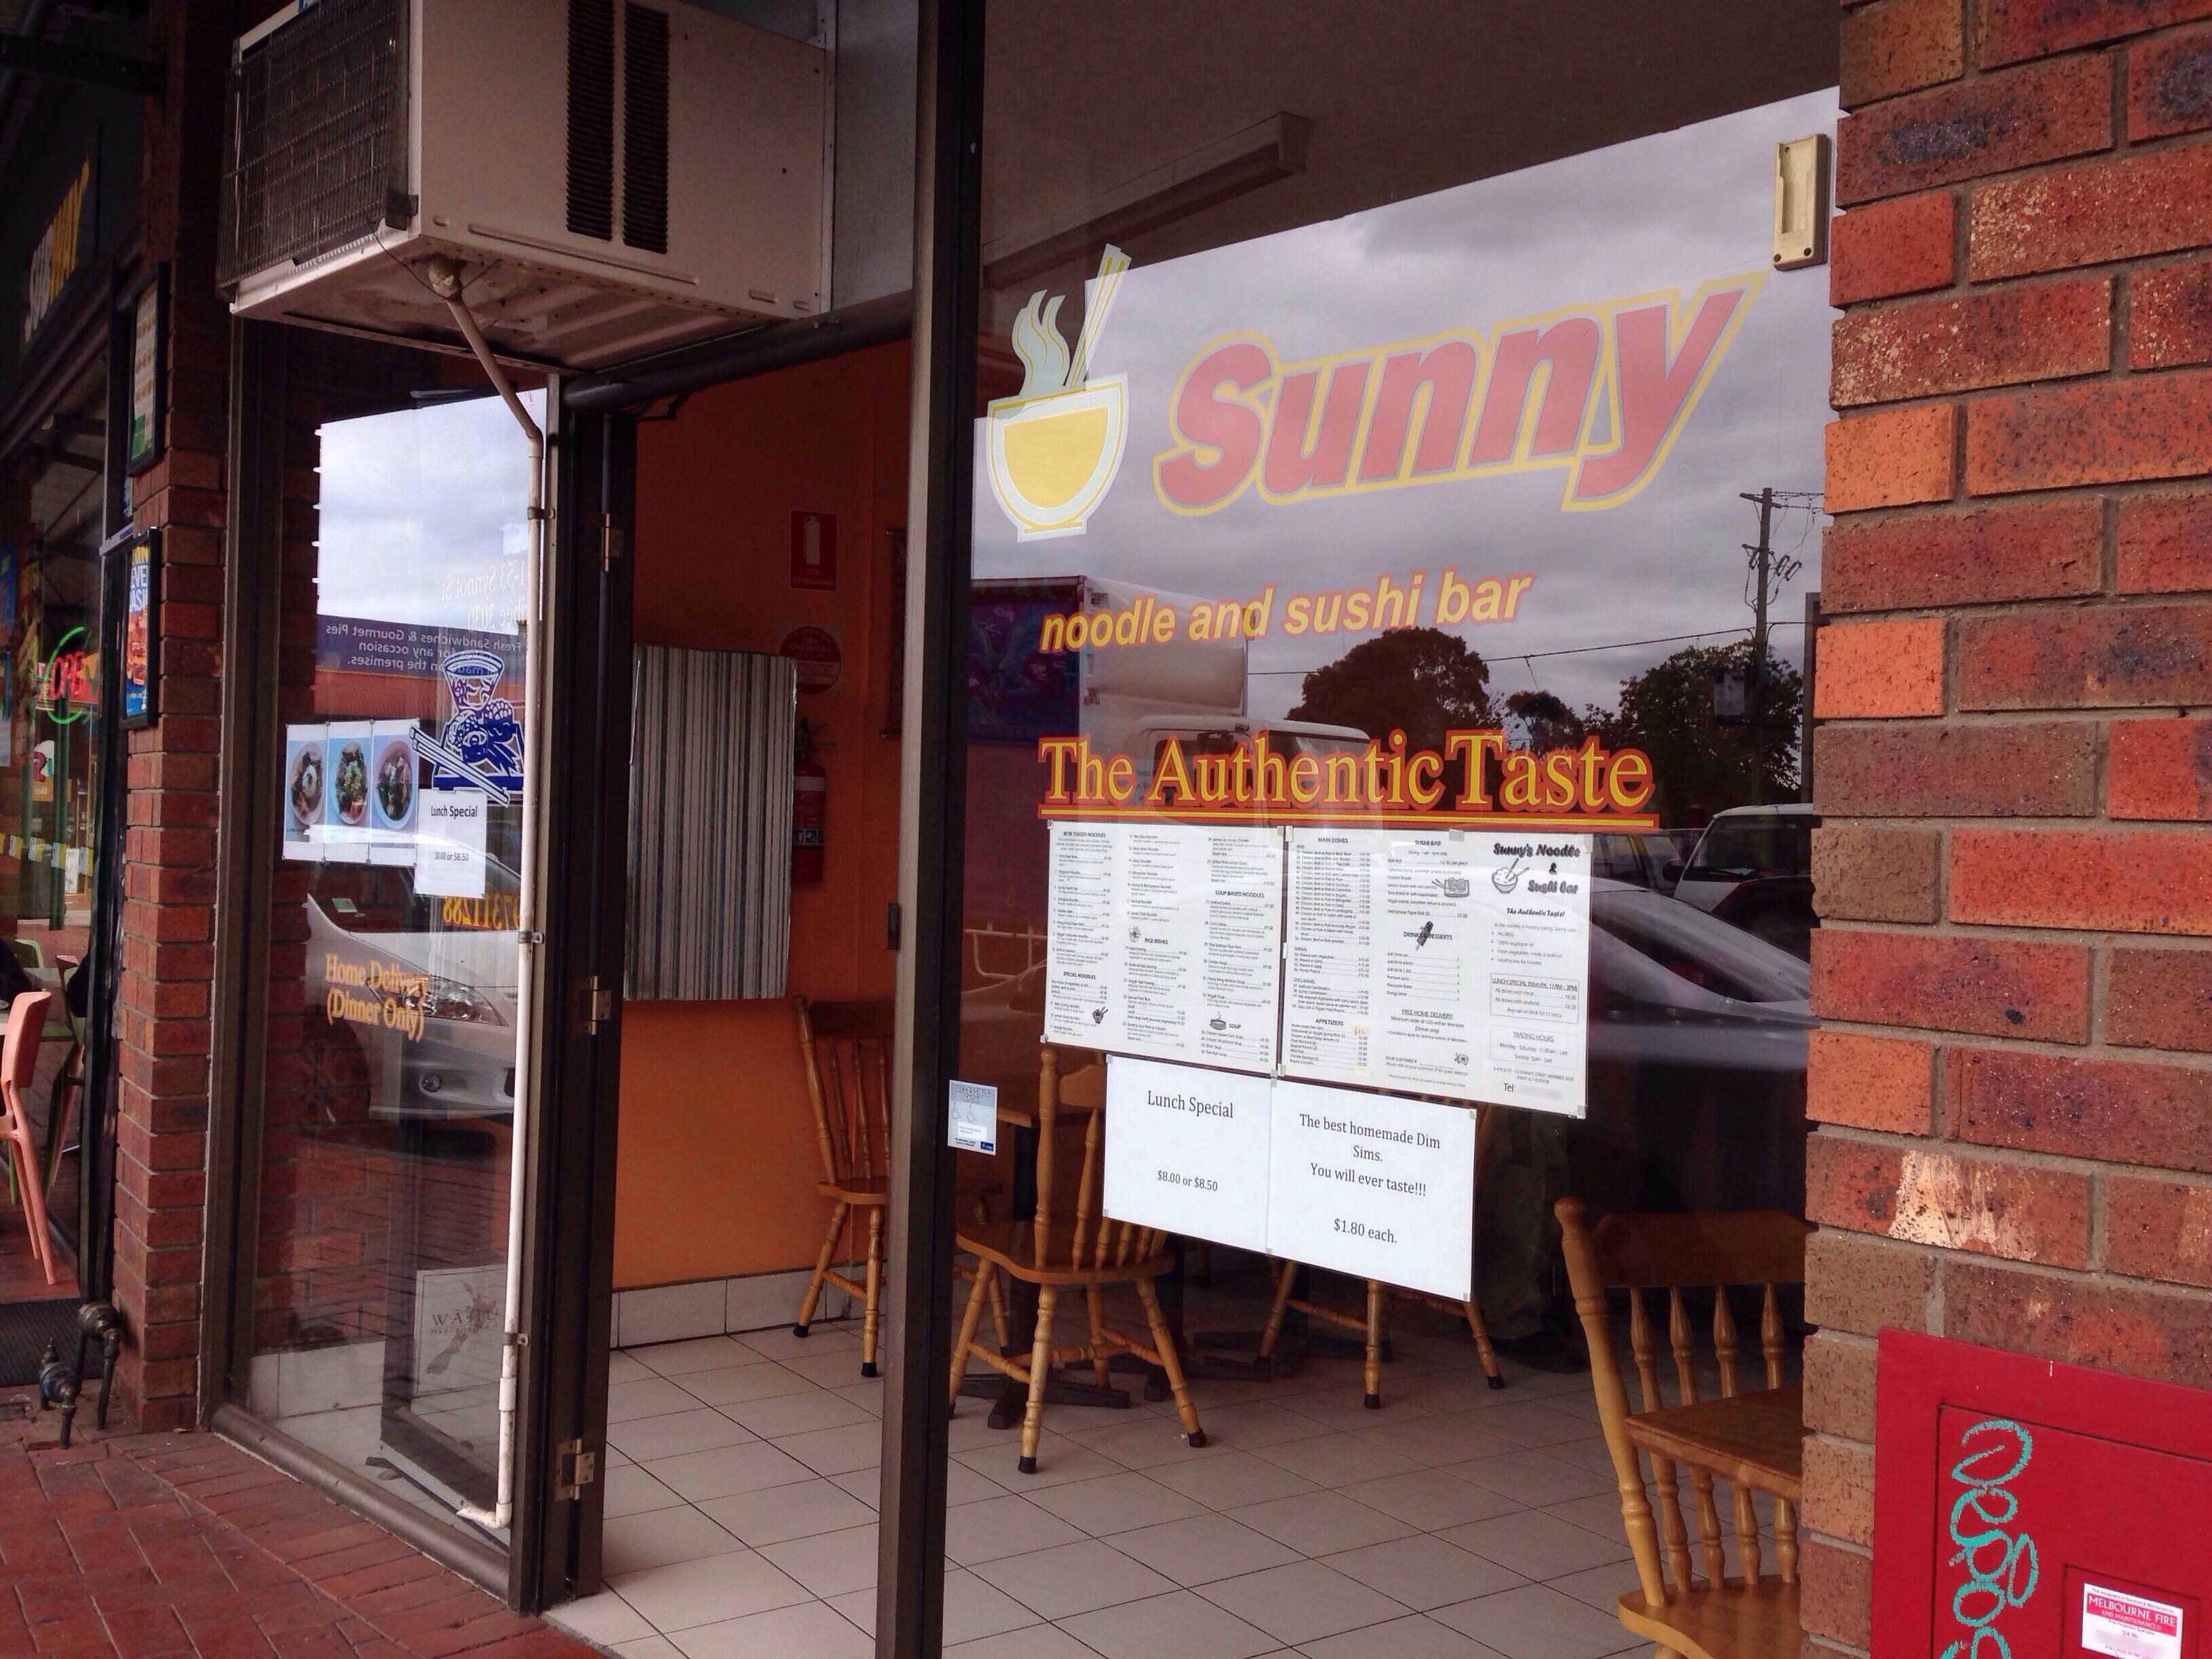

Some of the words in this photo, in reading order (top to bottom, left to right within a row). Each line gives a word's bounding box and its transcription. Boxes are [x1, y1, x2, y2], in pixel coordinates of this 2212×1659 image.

[1152, 271, 1765, 515] Sunny
[1039, 594, 1176, 653] noodle
[1188, 583, 1275, 640] and
[1284, 570, 1424, 636] sushi
[1436, 567, 1534, 626] bar
[1038, 733, 1136, 804] The
[1147, 729, 1446, 810] Authentic
[1446, 727, 1656, 813] Taste
[431, 805, 447, 817] Lunch
[449, 806, 477, 819] Special
[453, 853, 469, 861] $8.50
[1493, 843, 1534, 857] Sunny's
[1536, 844, 1580, 857] Noodle
[1549, 863, 1557, 875] &
[1528, 880, 1557, 894] Sushi
[1518, 908, 1546, 916] Authentic
[325, 952, 366, 987] Home
[369, 959, 429, 1002] Delivery
[327, 987, 381, 1025] (Dinner
[383, 998, 424, 1043] Only)
[1513, 1031, 1534, 1040] TRADING
[1536, 1034, 1554, 1042] HOURS
[954, 1085, 990, 1097] ACCESSIBLE
[1504, 1083, 1514, 1092] Tel
[964, 1094, 981, 1104] ENTRY
[1148, 1090, 1185, 1110] Lunch
[1189, 1097, 1233, 1118] Special
[1300, 1113, 1320, 1128] The
[1324, 1117, 1347, 1133] best
[1350, 1121, 1413, 1144] homemade
[1416, 1132, 1441, 1149] Dim
[1353, 1145, 1383, 1162] Sims.
[1158, 1170, 1181, 1184] $8.00
[1183, 1177, 1192, 1186] or
[1194, 1177, 1218, 1191] $8.50
[1311, 1162, 1331, 1178] You
[1335, 1168, 1355, 1183] will
[1358, 1175, 1383, 1187] ever
[1387, 1178, 1426, 1196] taste!!!
[1334, 1218, 1365, 1236] $1.80
[1368, 1228, 1397, 1244] each.
[2089, 1595, 2152, 1620] MELBOURNE
[2155, 1615, 2176, 1626] FIRE
